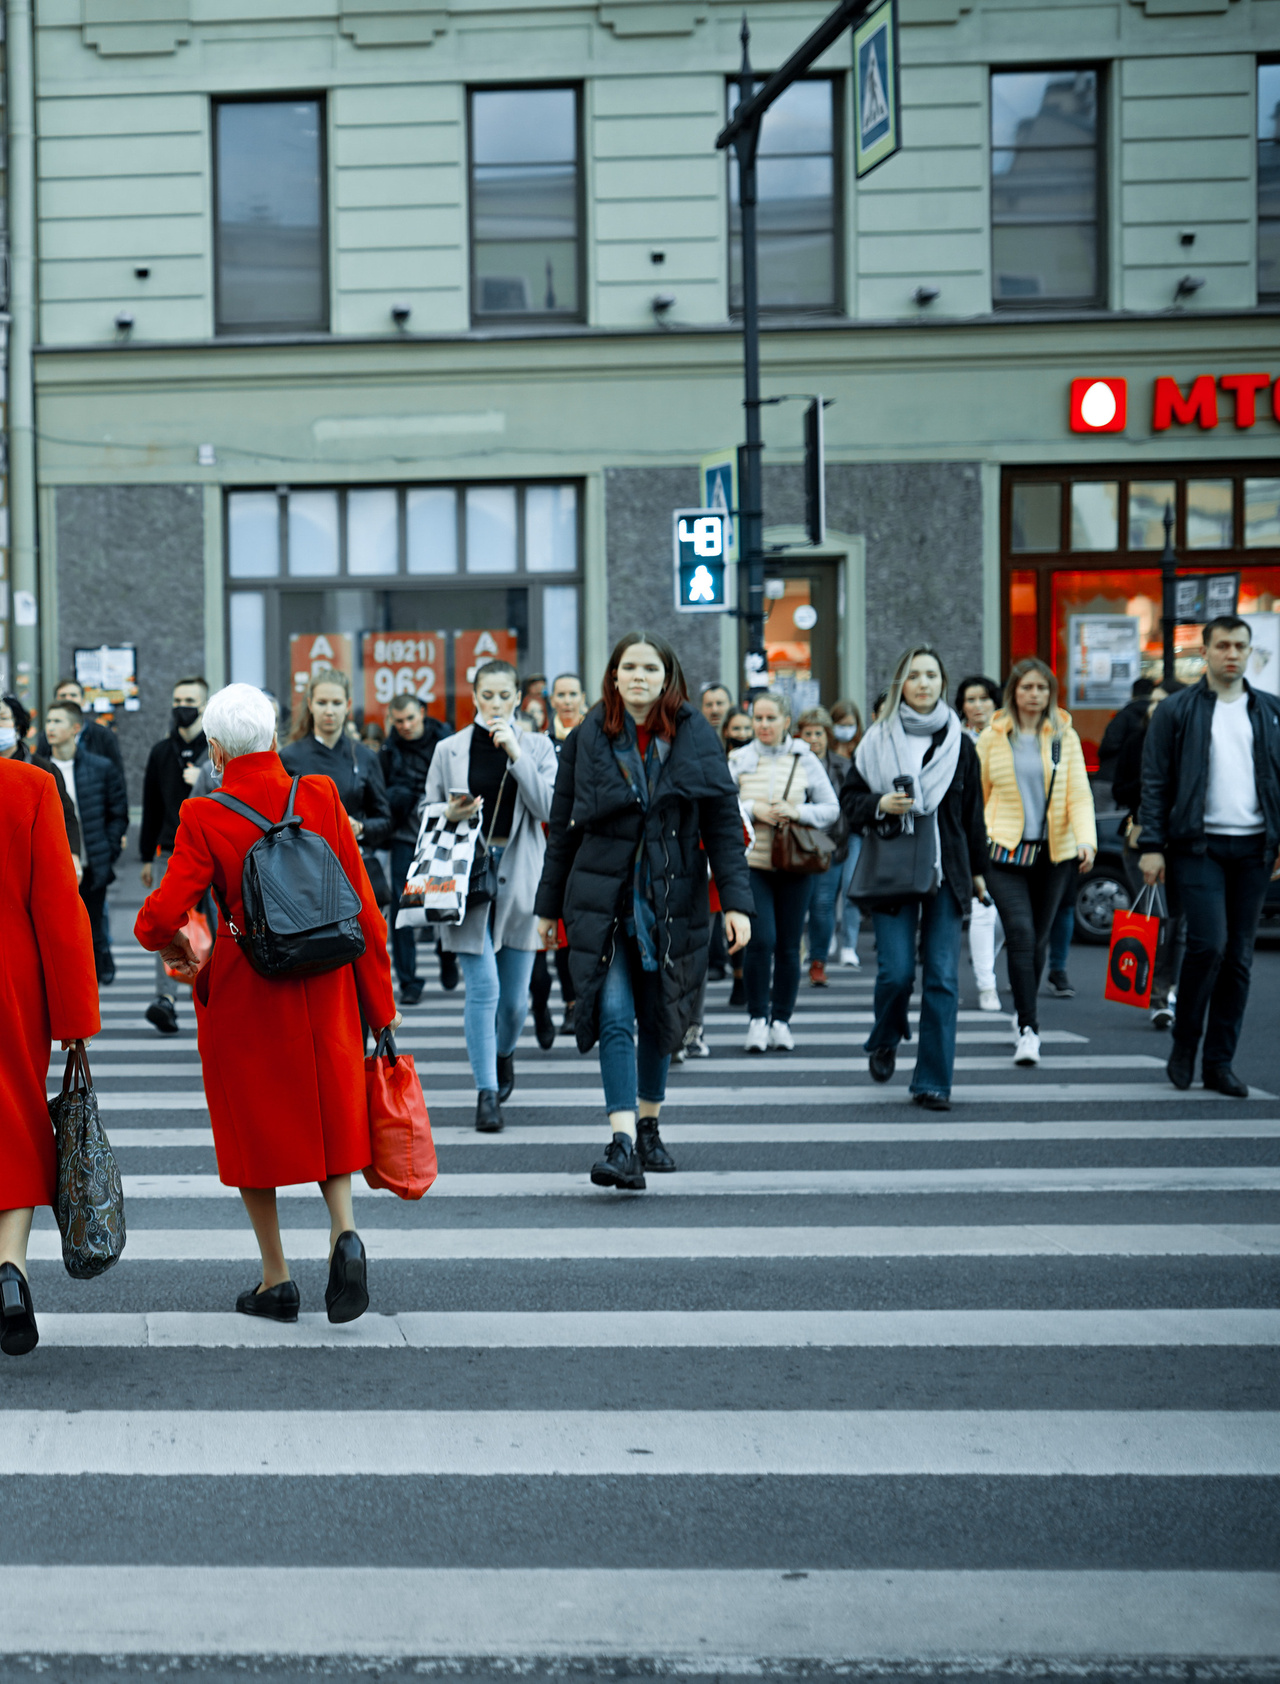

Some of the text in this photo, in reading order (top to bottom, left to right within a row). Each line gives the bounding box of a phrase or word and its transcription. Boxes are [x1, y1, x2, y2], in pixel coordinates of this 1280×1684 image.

[1153, 373, 1280, 431] МТ
[679, 517, 722, 557] 48
[374, 639, 436, 664] 8(921)
[374, 666, 436, 704] 962
